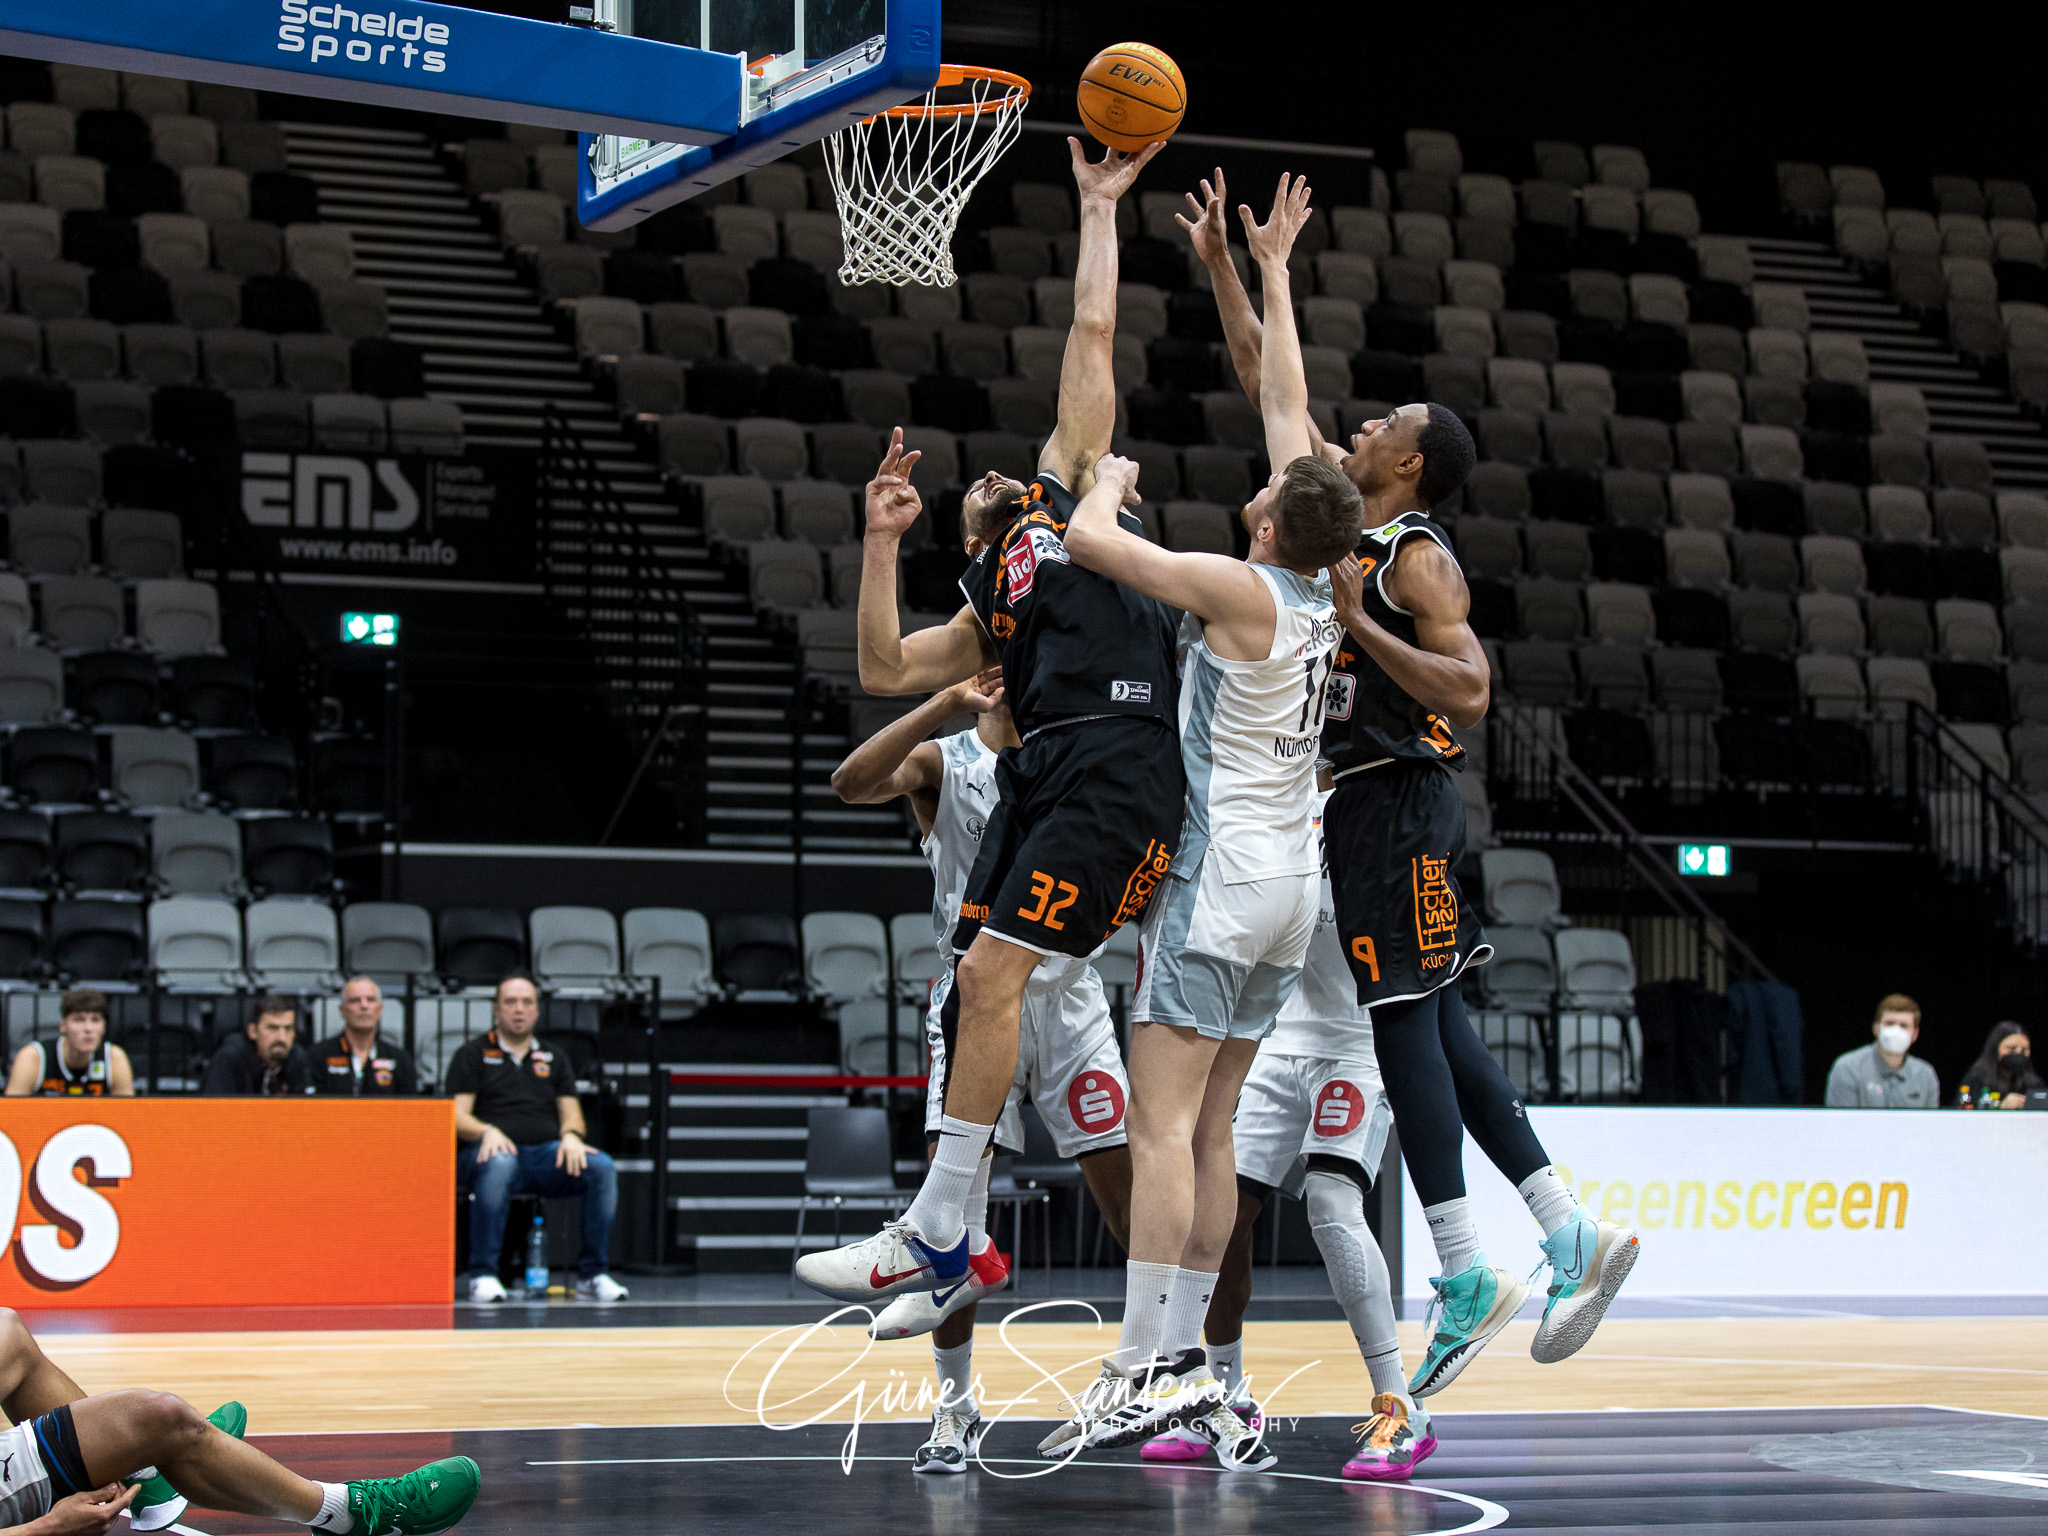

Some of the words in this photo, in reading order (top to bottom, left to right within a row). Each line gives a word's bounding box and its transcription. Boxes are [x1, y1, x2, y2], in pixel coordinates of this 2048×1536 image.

[277, 24, 446, 73] Sports
[280, 0, 450, 46] Schelde
[279, 537, 458, 566] www.ems.info
[1017, 870, 1079, 931] 32
[1412, 854, 1444, 951] Fischer
[1352, 936, 1380, 982] 9
[0, 1124, 132, 1291] S
[1535, 1164, 1910, 1230] reenscreen
